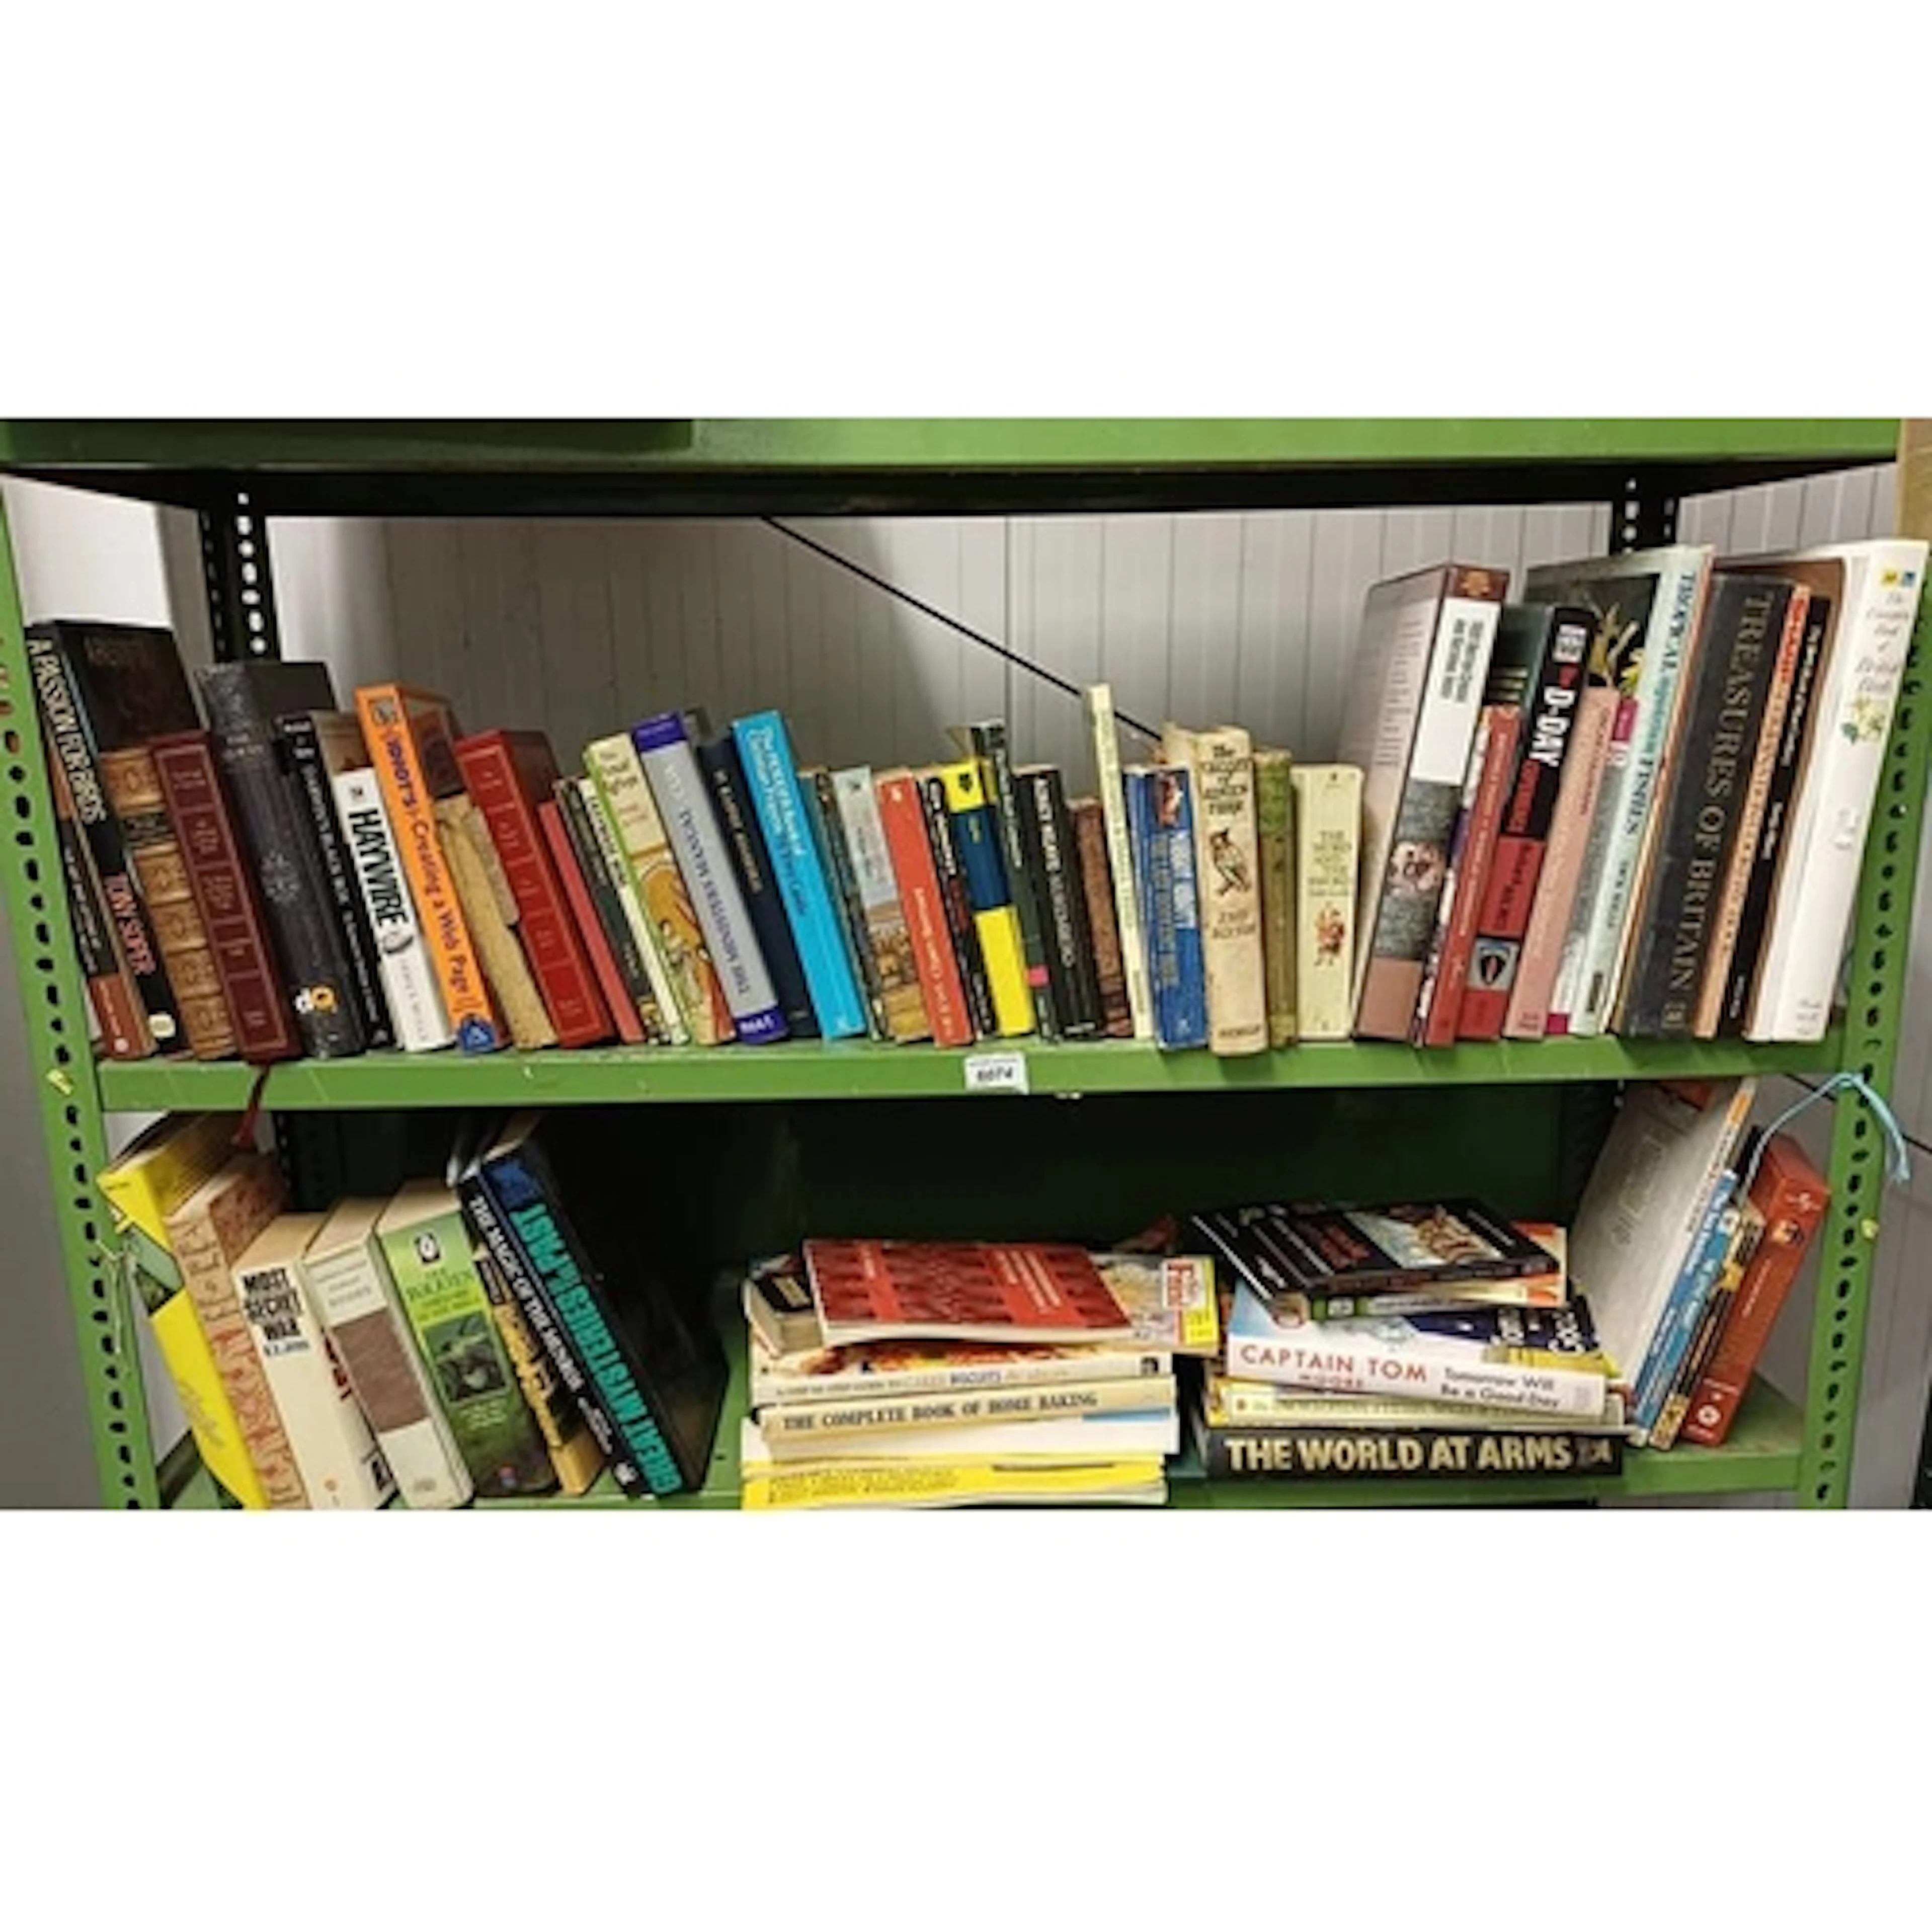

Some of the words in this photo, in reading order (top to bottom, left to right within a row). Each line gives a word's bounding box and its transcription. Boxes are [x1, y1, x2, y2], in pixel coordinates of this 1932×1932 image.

[29, 635, 52, 656] A
[33, 651, 79, 738] PASSION
[1705, 593, 1770, 800] TREASURES
[60, 733, 88, 771] FOR
[1526, 684, 1577, 769] D-DAY
[71, 766, 107, 827] BIRDS
[1695, 803, 1725, 851] OF
[350, 805, 408, 931] HAYWIRE
[409, 817, 447, 900] Creating
[104, 867, 138, 920] TONY
[432, 898, 447, 910] a
[120, 916, 156, 979] SOPER
[438, 909, 463, 952] Web
[1666, 855, 1715, 993] BRITAIN
[447, 953, 474, 995] Page
[510, 1197, 570, 1275] PAST
[555, 1282, 647, 1426] MYSTERIES
[1240, 1343, 1353, 1372] CAPTAIN
[1369, 1358, 1428, 1383] TOM
[1445, 1367, 1517, 1388] Tomorrow
[1522, 1374, 1555, 1389] Will
[784, 1415, 814, 1430] THE
[822, 1406, 905, 1428] COMPLETE
[912, 1404, 954, 1420] BOOK
[962, 1401, 982, 1415] OF
[989, 1396, 1031, 1414] HOME
[1039, 1392, 1098, 1410] BAKING
[1441, 1384, 1459, 1396] Be
[1464, 1388, 1475, 1398] a
[1480, 1388, 1523, 1404] Good
[1529, 1392, 1561, 1408] Day
[622, 1412, 682, 1497] GREAT
[1224, 1437, 1294, 1472] THE
[1298, 1437, 1424, 1472] WORLD
[1429, 1435, 1472, 1471] AT
[1477, 1435, 1574, 1471] ARMS
